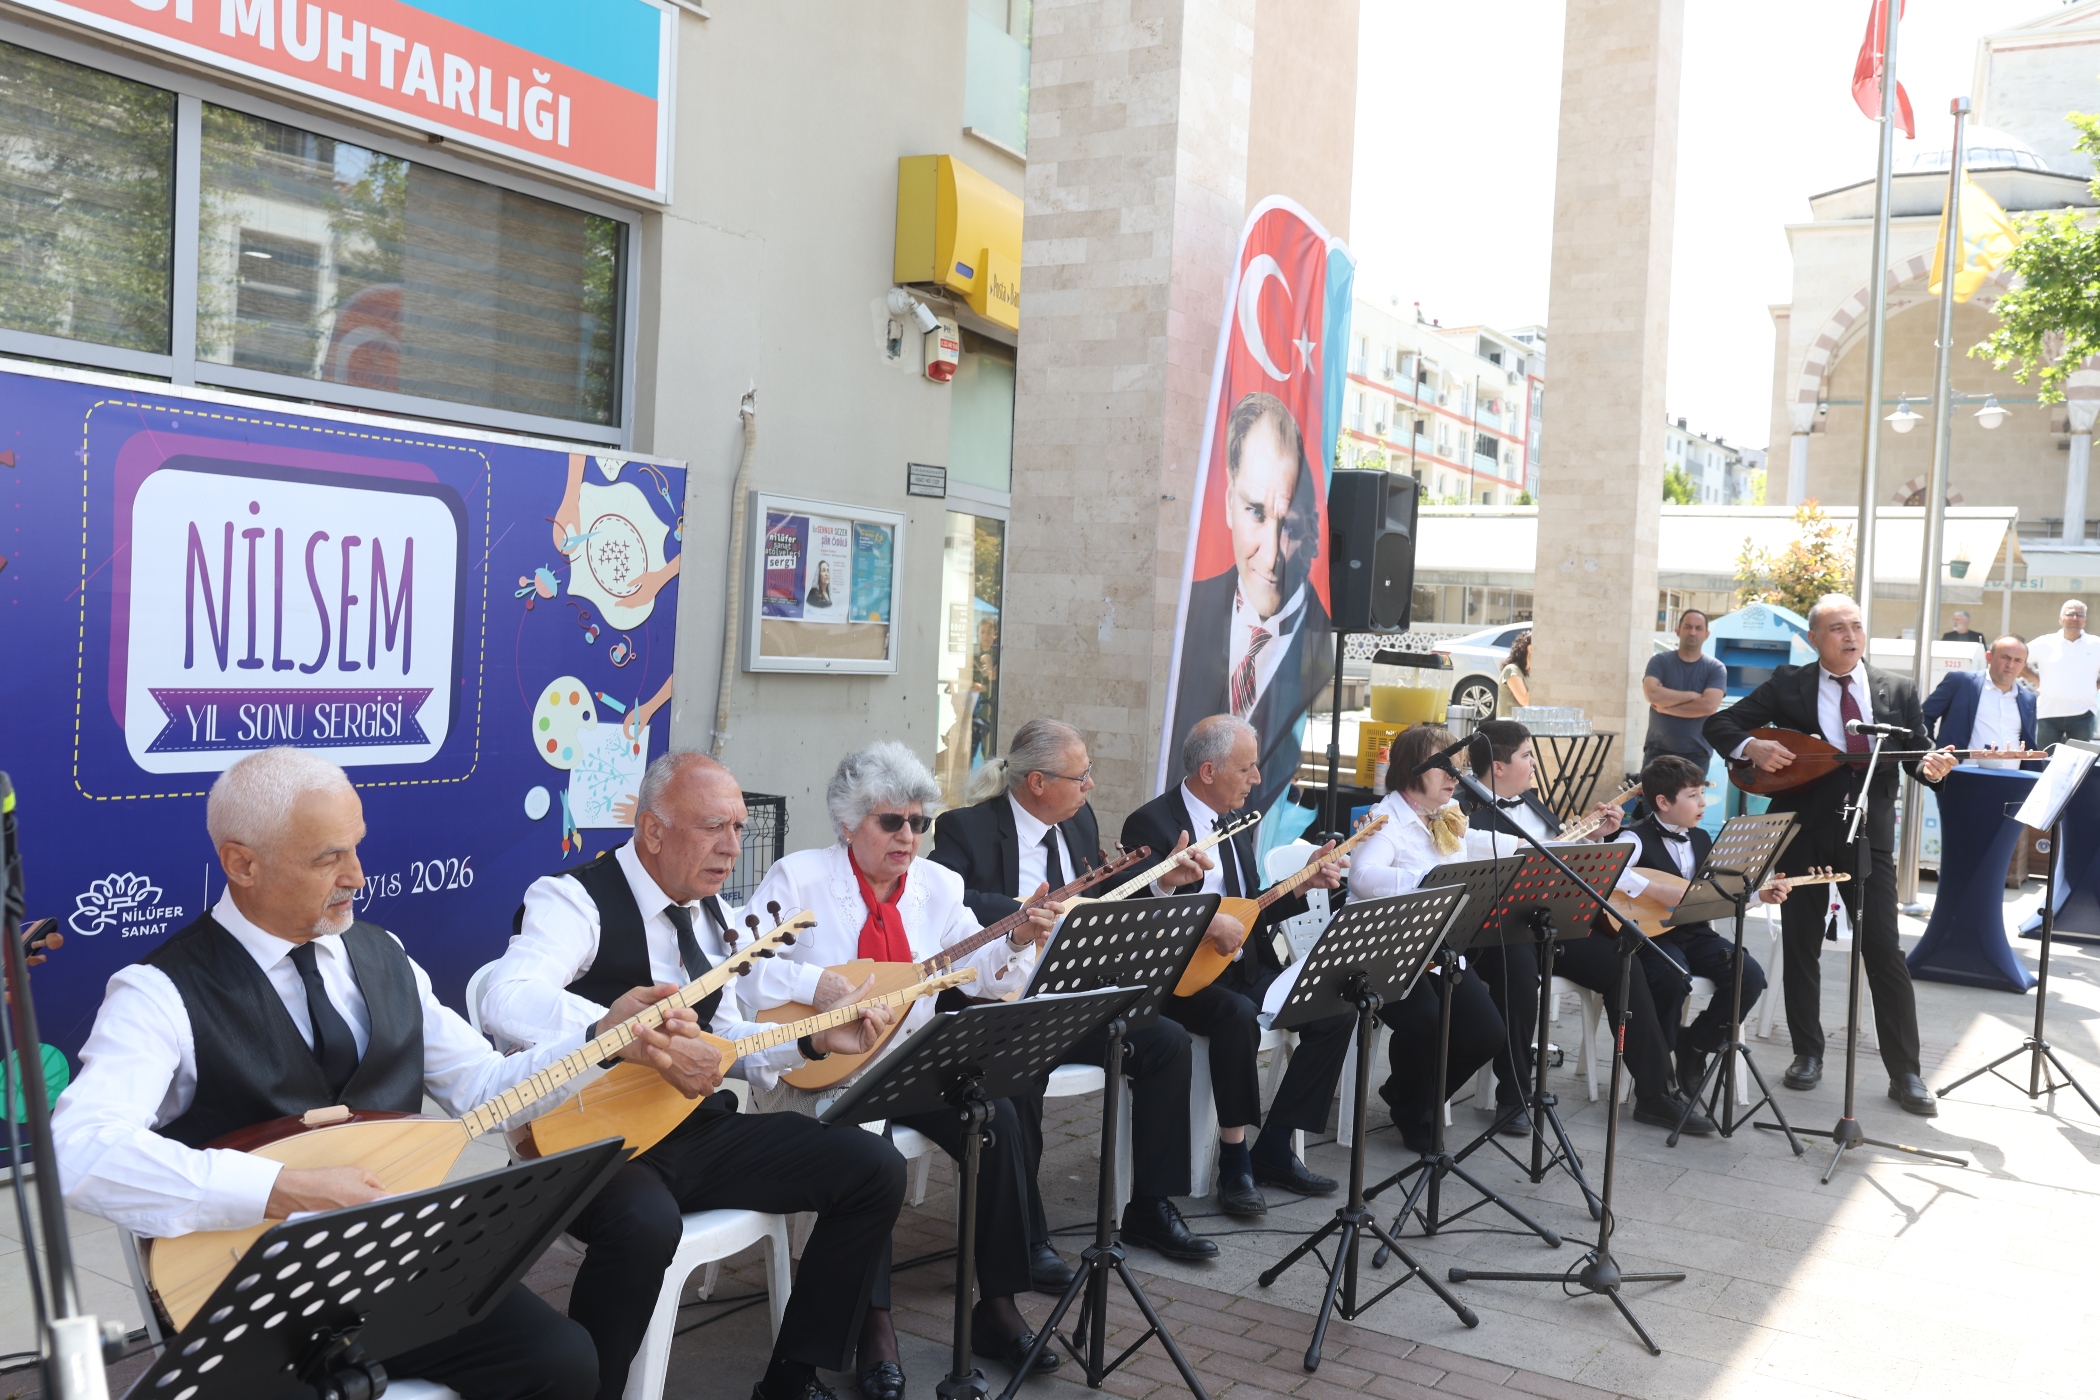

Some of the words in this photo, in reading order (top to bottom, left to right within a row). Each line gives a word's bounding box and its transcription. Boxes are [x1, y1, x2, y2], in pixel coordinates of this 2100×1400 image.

[219, 0, 571, 148] MUHTARLIĞI
[993, 273, 1006, 303] Posta
[769, 533, 797, 543] nilüfer
[834, 527, 848, 537] SEZER
[773, 542, 792, 550] sanat
[183, 500, 414, 676] NİLSEM
[1944, 660, 1962, 668] 5213
[185, 704, 226, 742] YIL
[237, 703, 305, 741] SONU
[312, 695, 403, 739] SERGİSİ
[410, 855, 474, 894] 2026
[122, 906, 184, 923] NİLÜFER
[121, 922, 168, 938] SANAT
